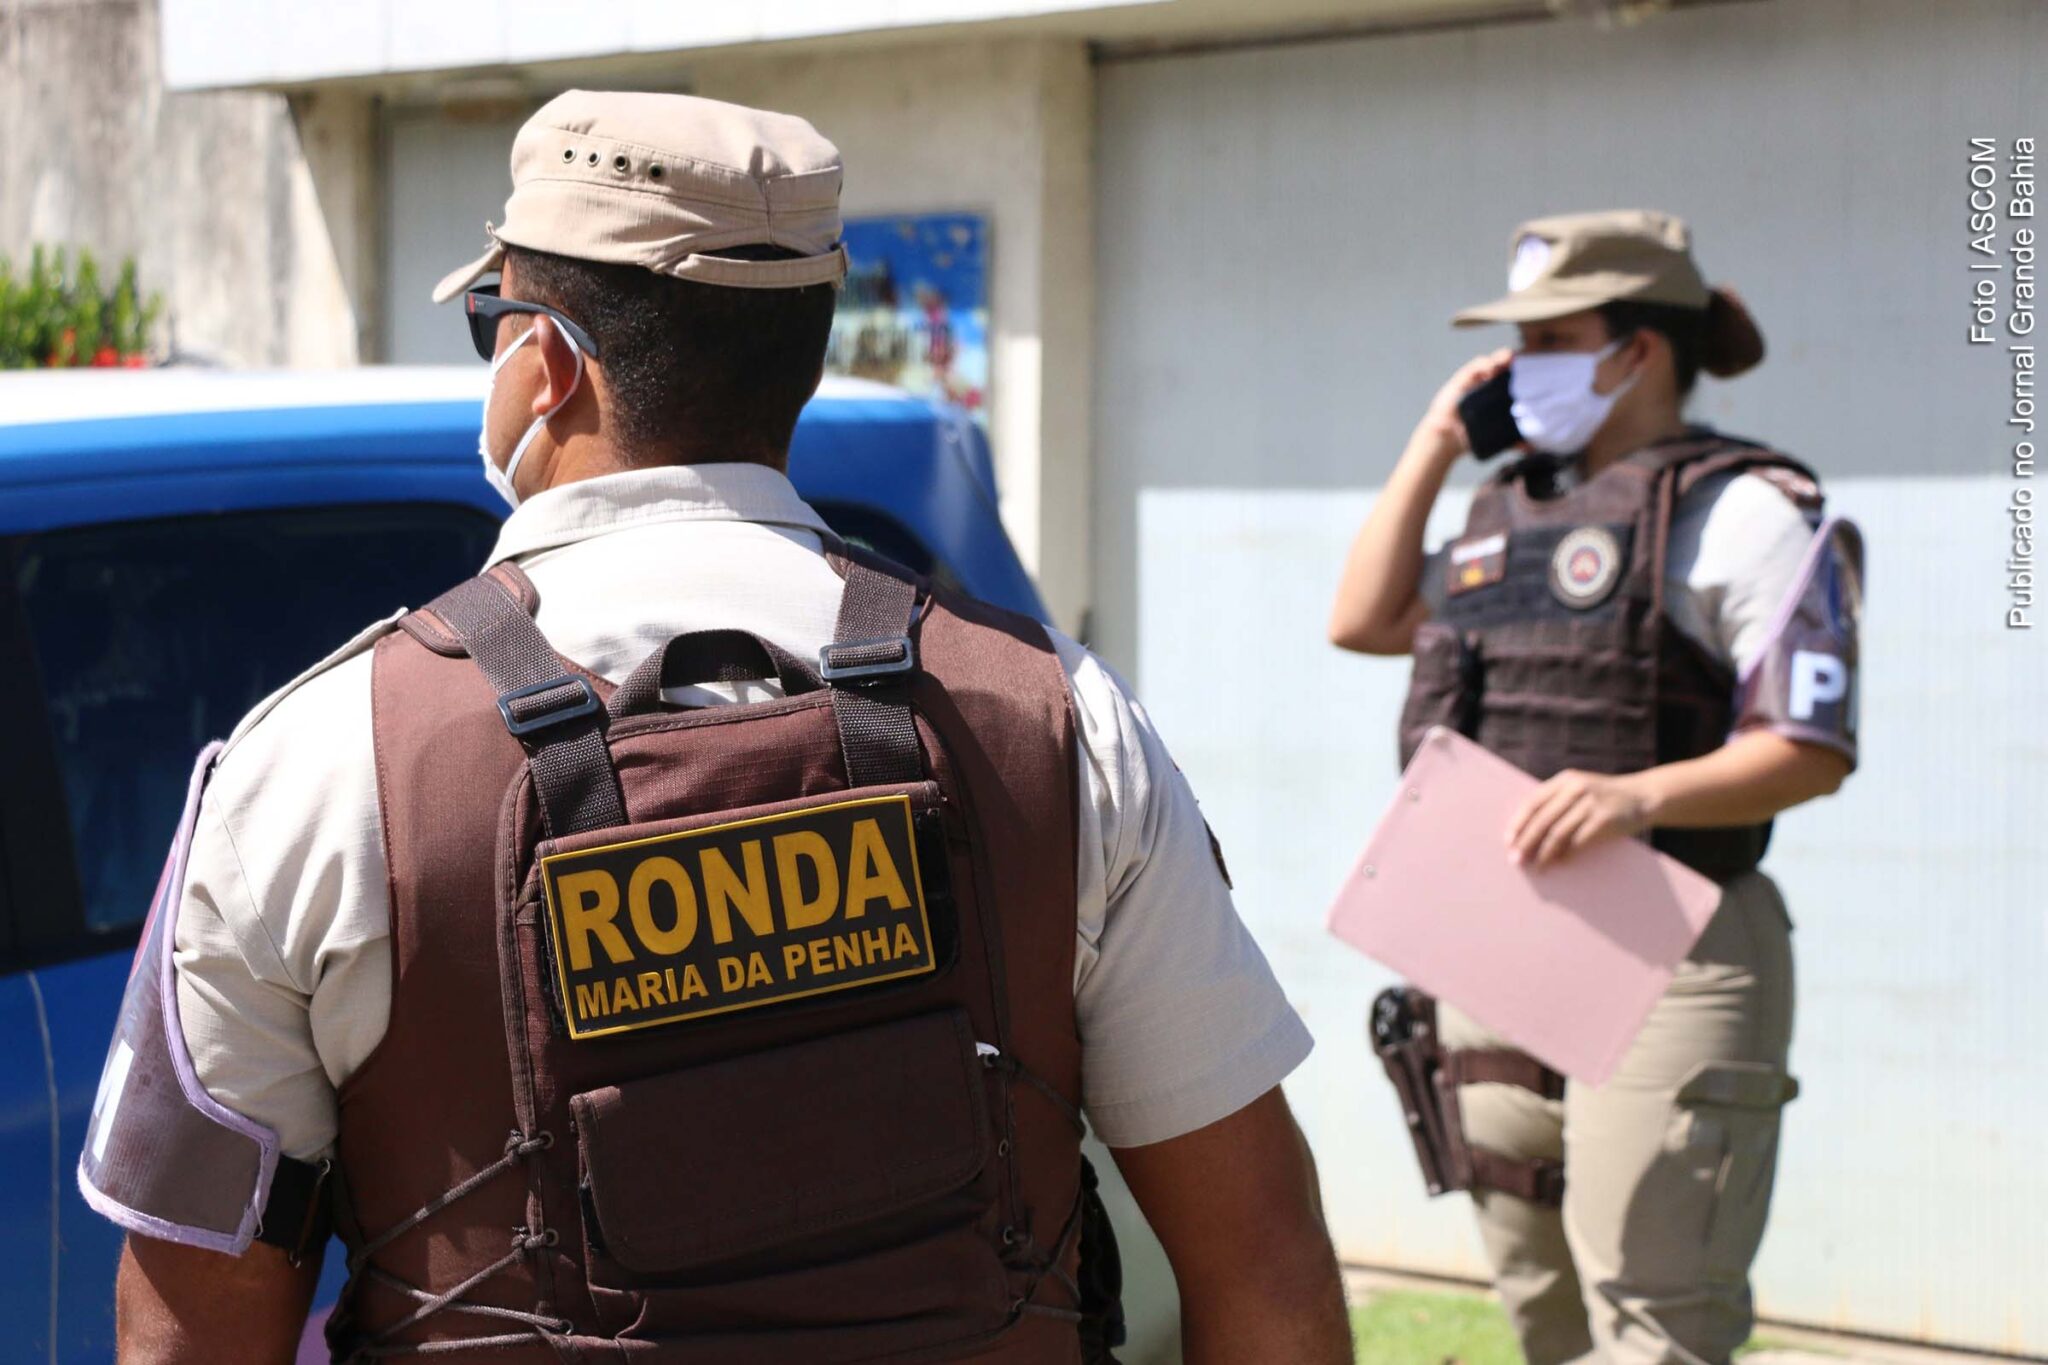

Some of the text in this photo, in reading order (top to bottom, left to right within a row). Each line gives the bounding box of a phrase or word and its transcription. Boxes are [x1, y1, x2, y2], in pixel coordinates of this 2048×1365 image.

[1788, 650, 1847, 720] P
[556, 817, 913, 973] RONDA
[575, 922, 920, 1021] MARIA DA PENHA
